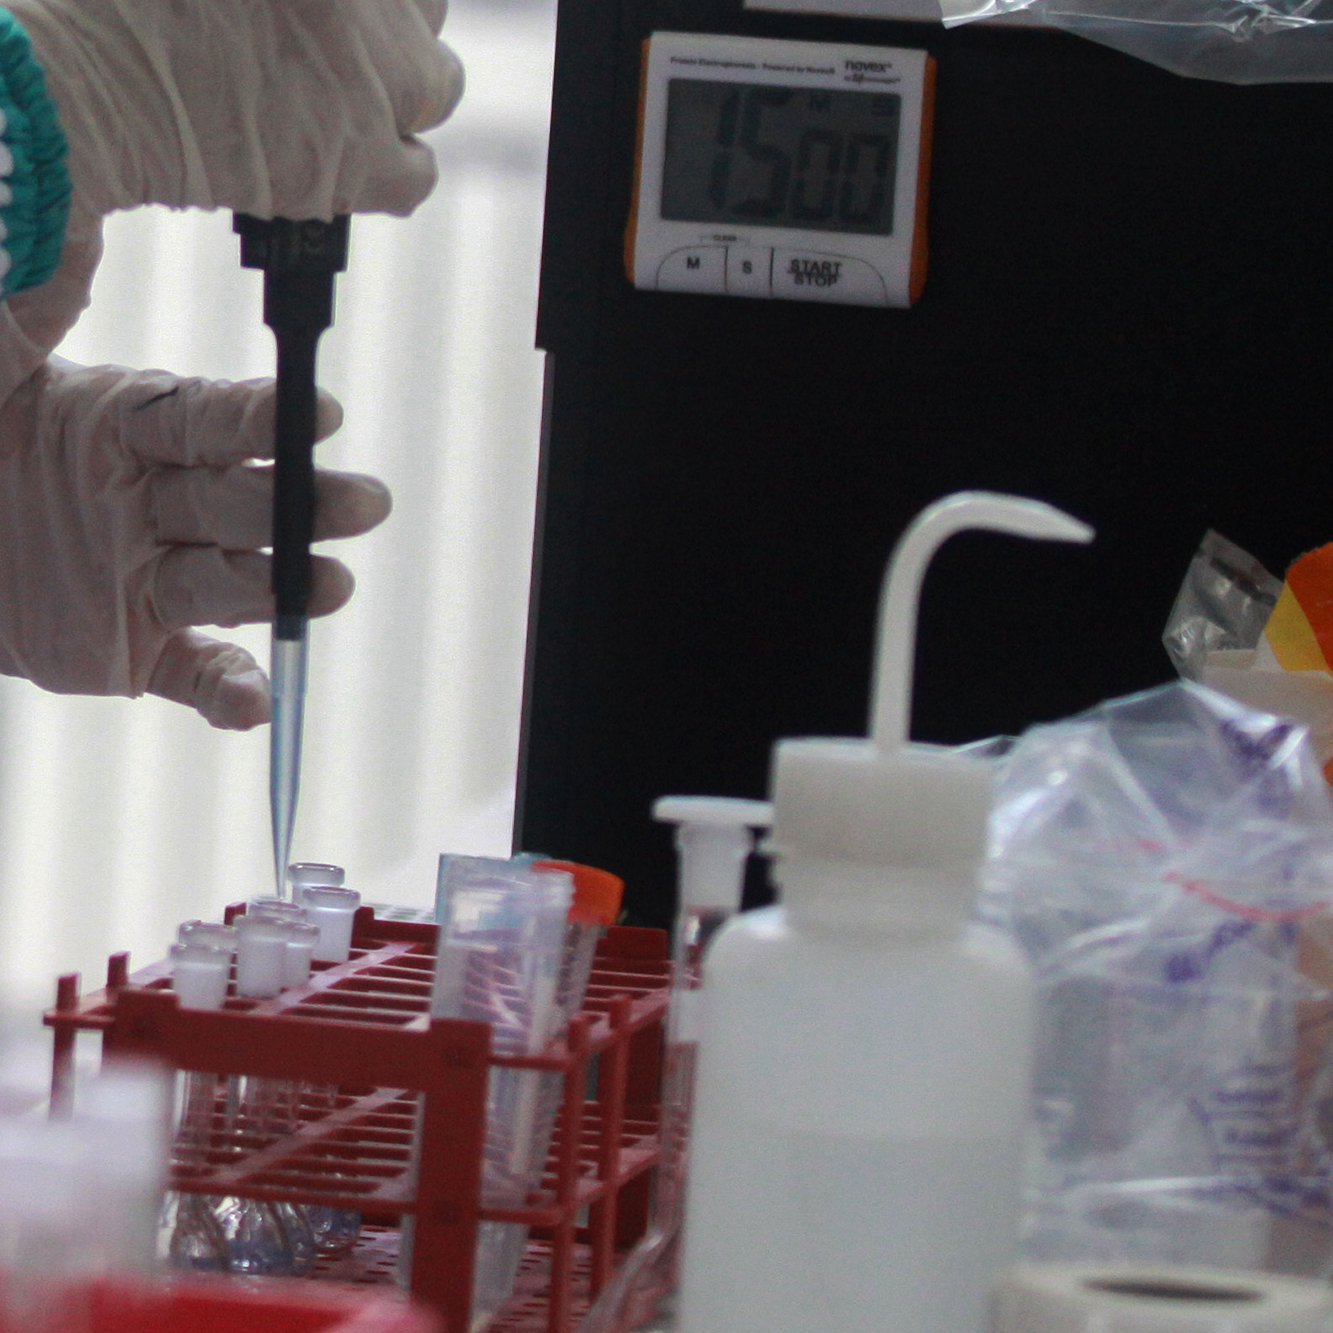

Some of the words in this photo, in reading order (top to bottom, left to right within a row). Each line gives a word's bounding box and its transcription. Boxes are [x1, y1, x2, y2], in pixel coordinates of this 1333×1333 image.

[686, 256, 701, 271] M
[741, 260, 753, 274] S
[790, 258, 842, 276] START
[794, 272, 838, 287] STOP
